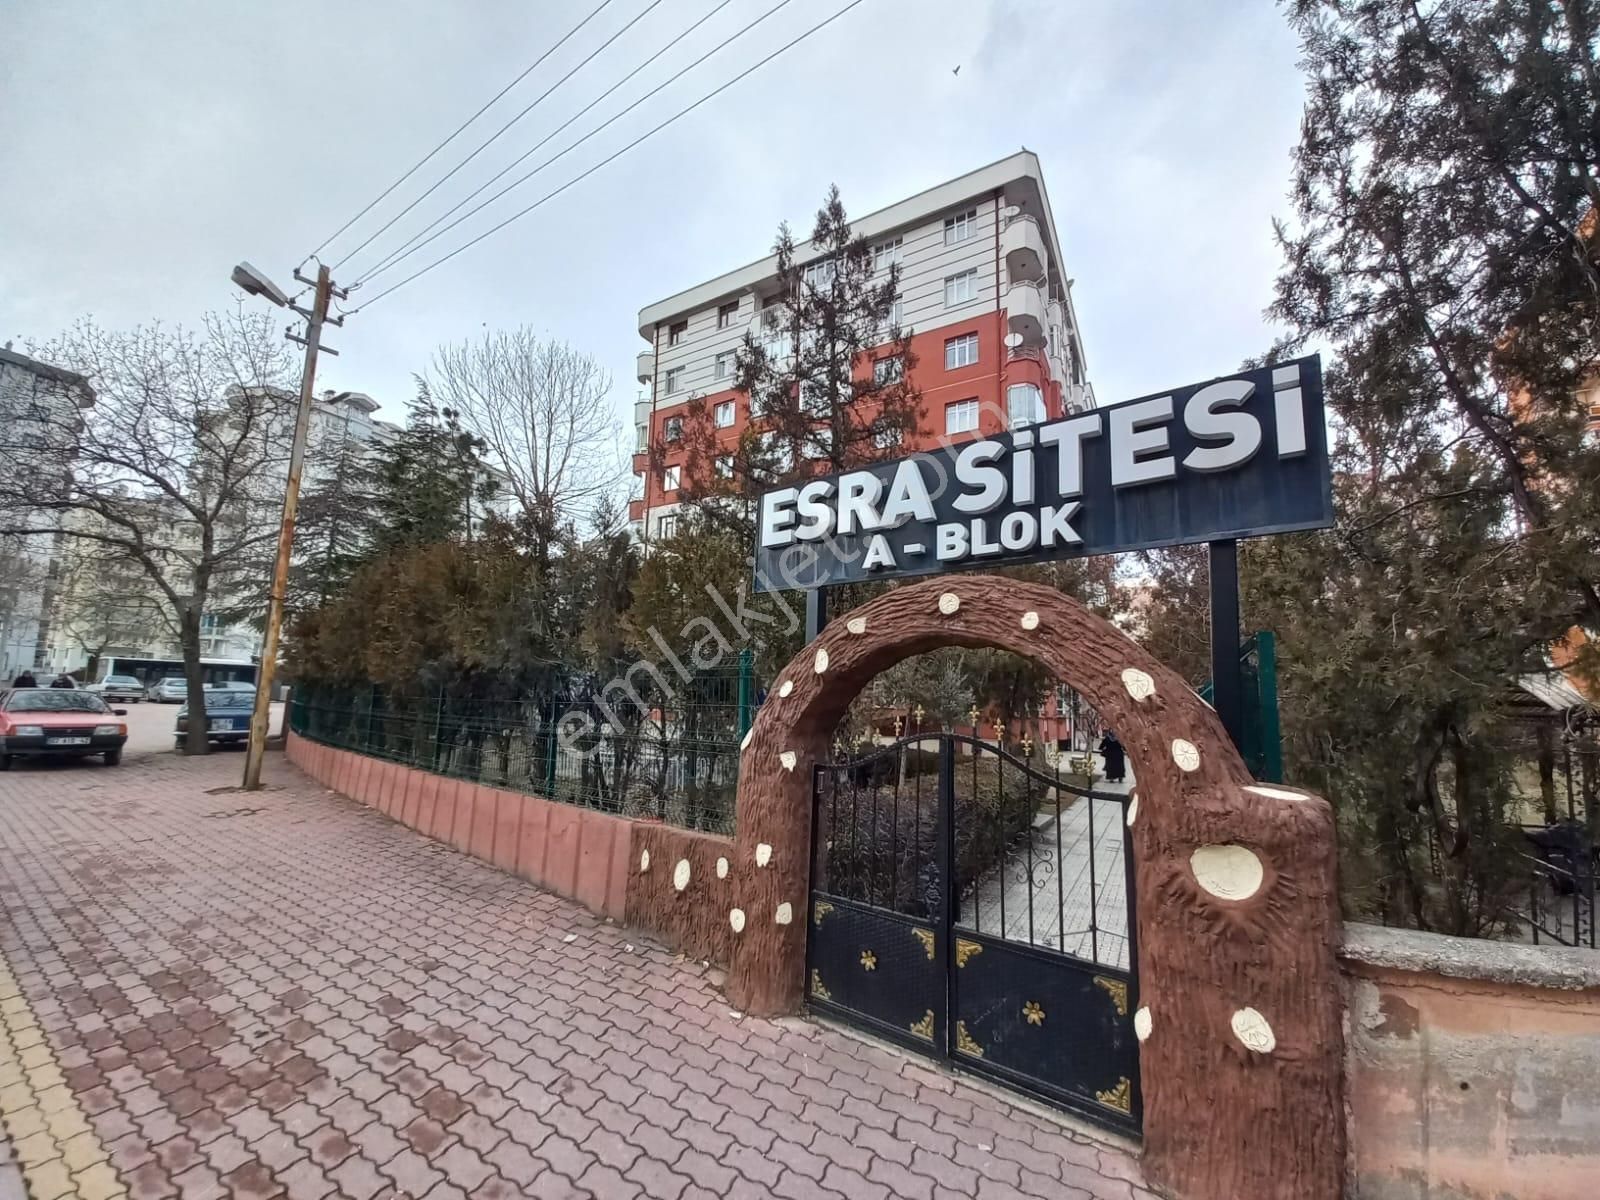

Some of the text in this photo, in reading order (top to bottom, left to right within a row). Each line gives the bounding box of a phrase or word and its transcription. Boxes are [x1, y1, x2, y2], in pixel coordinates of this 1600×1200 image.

[761, 459, 938, 549] ESRA
[862, 533, 898, 571] A
[936, 501, 1084, 562] BLOK
